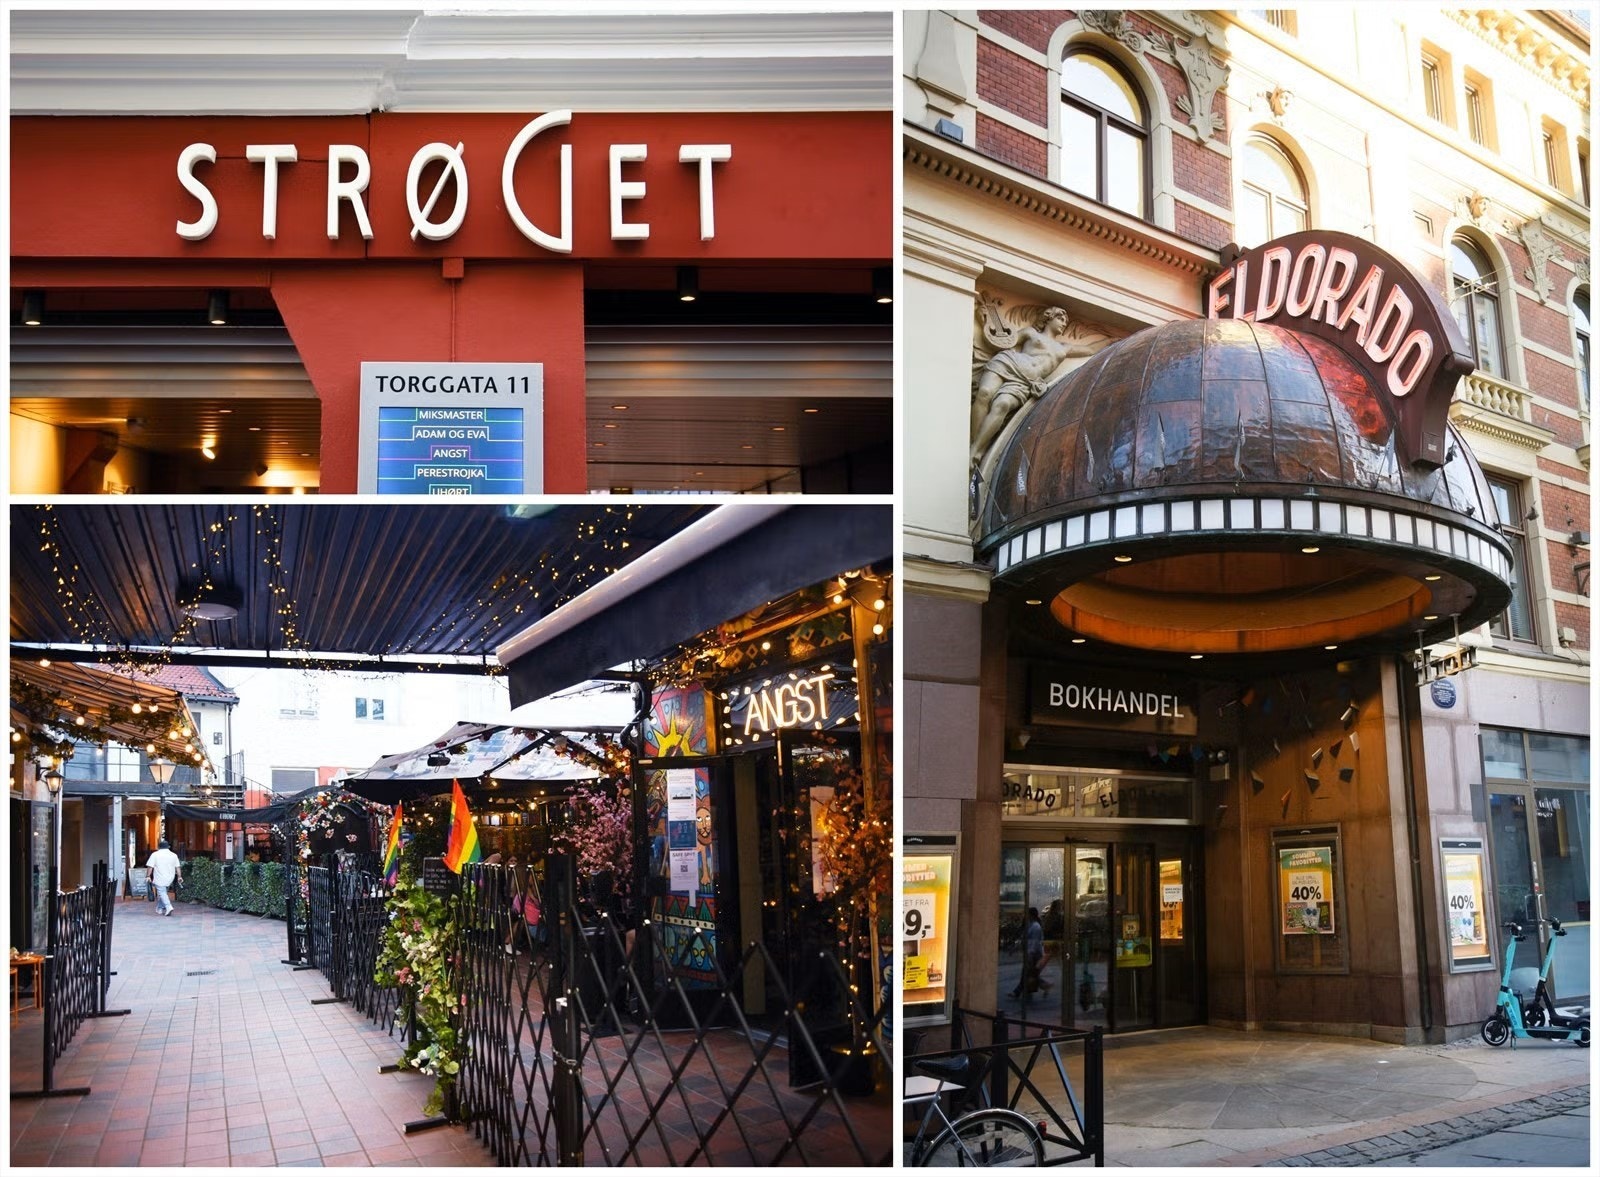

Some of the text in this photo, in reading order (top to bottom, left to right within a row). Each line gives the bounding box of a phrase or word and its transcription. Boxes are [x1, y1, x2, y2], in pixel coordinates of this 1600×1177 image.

[176, 109, 732, 254] STRØGET
[1208, 243, 1434, 397] ELDORADO
[375, 375, 529, 394] TORGGATA 11
[419, 410, 484, 420] MIKSMASTER
[415, 429, 486, 439] ADAM OG EVA
[433, 449, 468, 458] ANGST
[417, 468, 485, 478] PERESTROJKA
[744, 673, 835, 735] ANGST
[1049, 682, 1184, 718] BOKHANDEL
[1291, 885, 1322, 900] 40%
[903, 899, 914, 907] ET
[1450, 895, 1474, 909] 40%
[903, 909, 932, 939] 9,-
